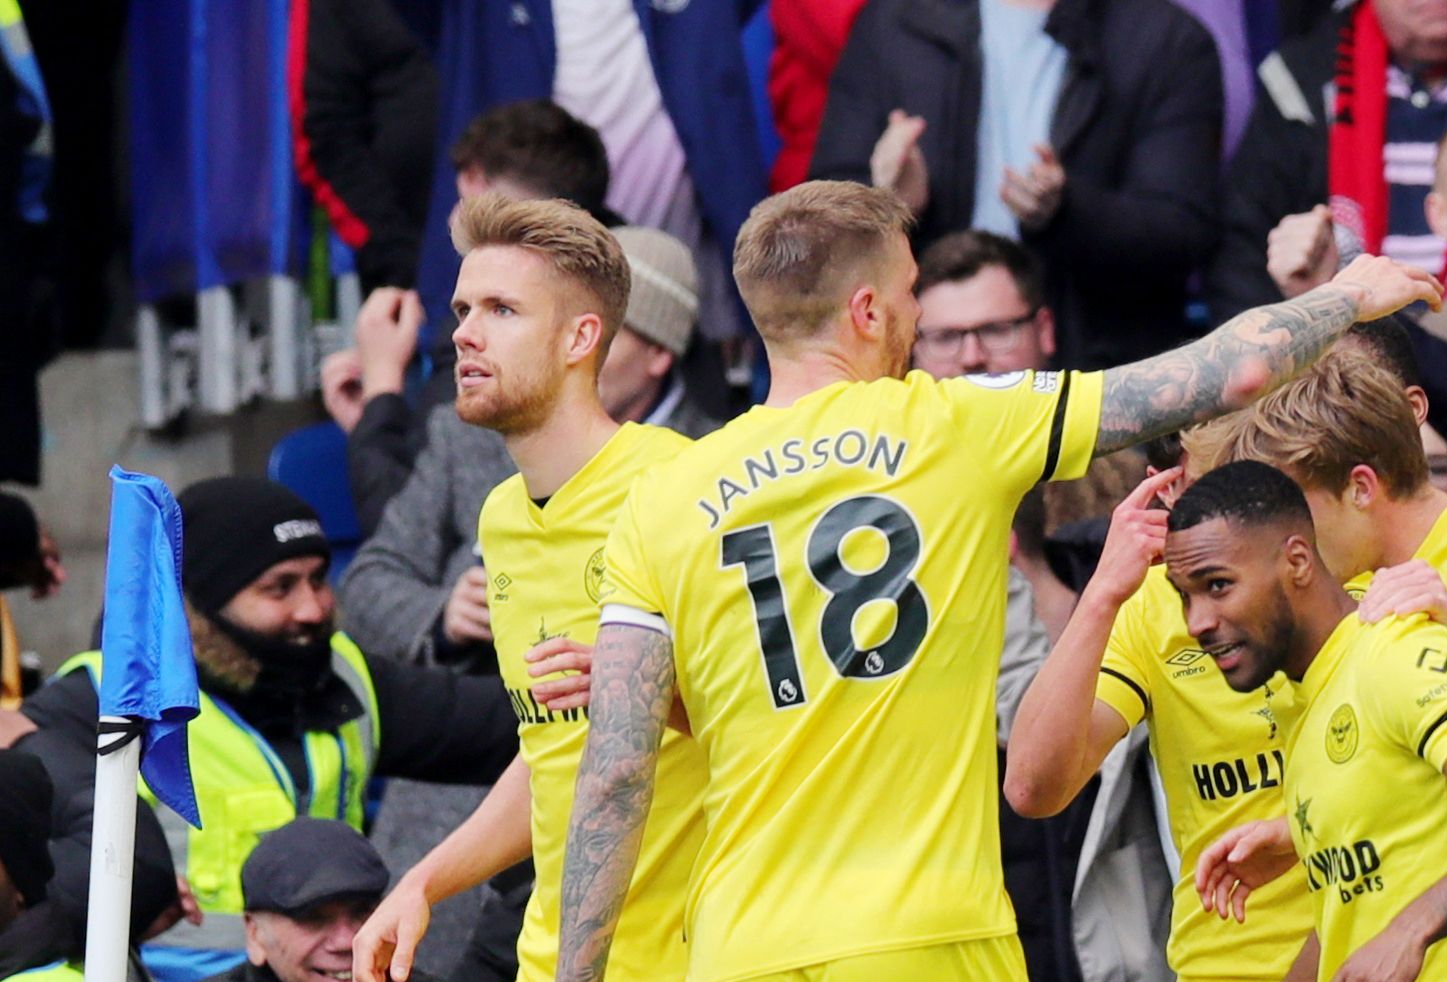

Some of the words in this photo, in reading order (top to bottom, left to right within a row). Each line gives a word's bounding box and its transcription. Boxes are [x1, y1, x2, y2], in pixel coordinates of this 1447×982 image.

[698, 430, 906, 529] JANSSON
[721, 493, 930, 710] 18
[1172, 665, 1206, 679] umbro
[1339, 875, 1384, 904] bets
